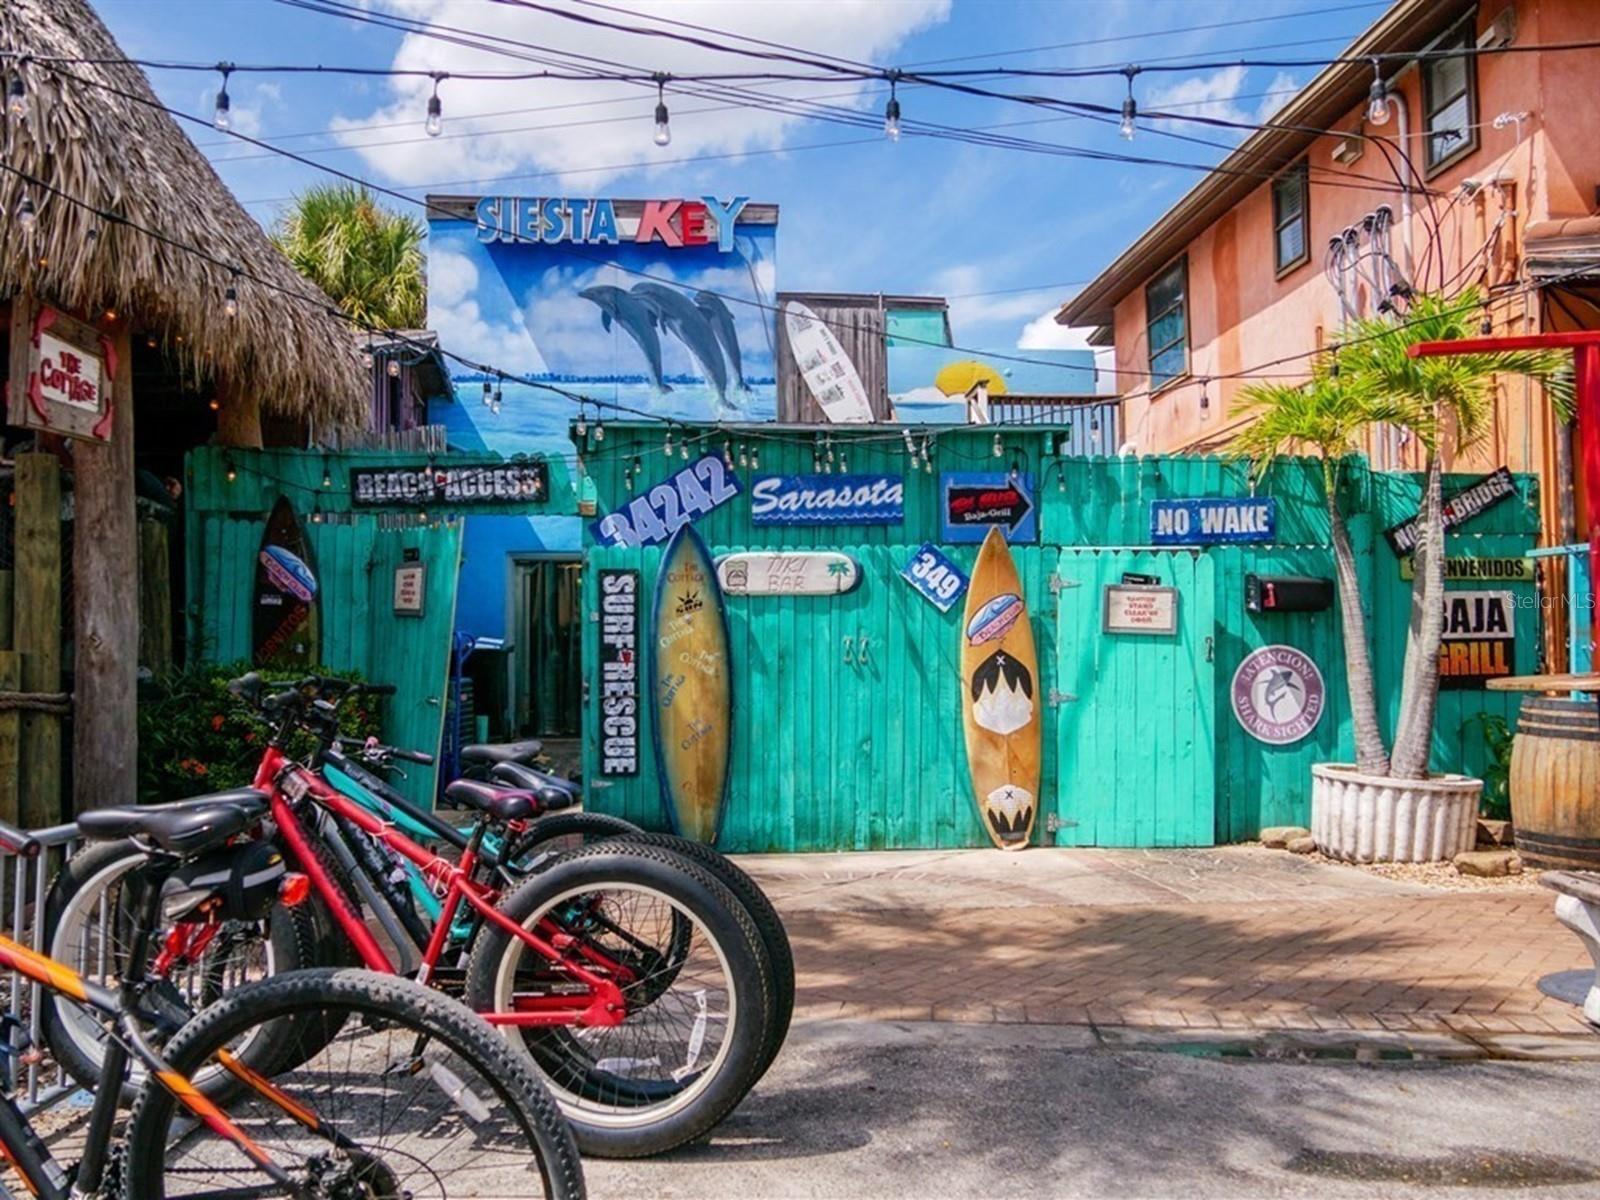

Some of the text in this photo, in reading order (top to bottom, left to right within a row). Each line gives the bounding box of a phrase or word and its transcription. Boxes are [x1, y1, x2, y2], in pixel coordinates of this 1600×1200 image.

[476, 196, 750, 252] SIESTA KEY
[357, 467, 538, 499] BEACH ACCESS
[600, 456, 738, 549] 34242
[751, 478, 903, 513] Sarasota
[1450, 471, 1512, 519] BRIDGE
[1156, 506, 1270, 536] NO WAKE
[767, 556, 807, 573] TIKI
[768, 575, 805, 592] BAR
[912, 553, 960, 599] 349
[603, 575, 636, 774] SURF RESCUE
[1238, 694, 1319, 737] SHARK SIGHTED
